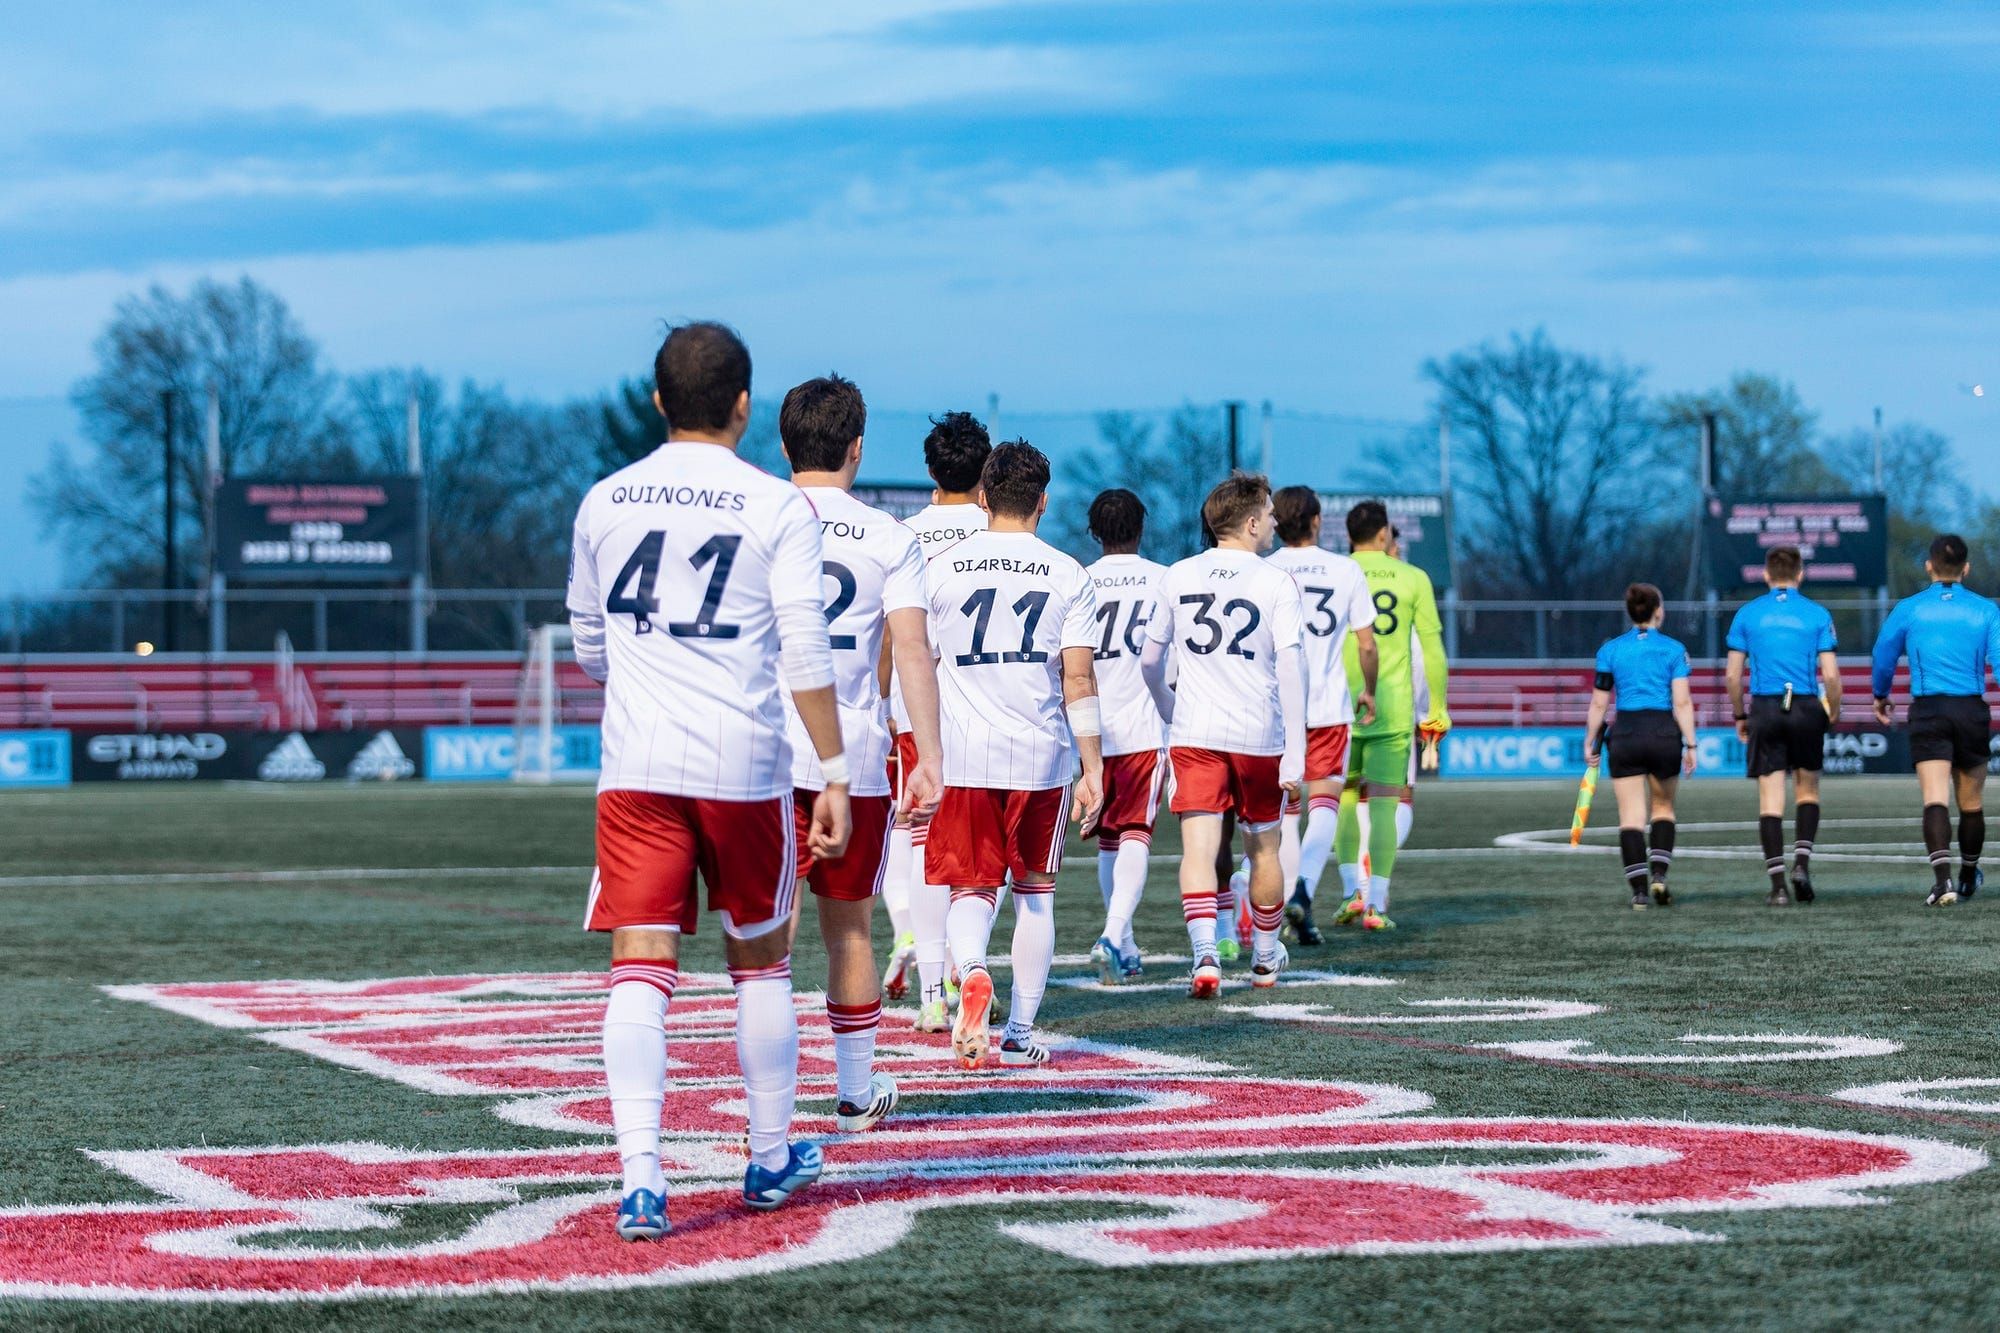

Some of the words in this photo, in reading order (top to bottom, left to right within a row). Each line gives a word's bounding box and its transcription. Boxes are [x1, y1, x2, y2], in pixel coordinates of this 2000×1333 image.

[611, 485, 746, 512] QUINONES
[821, 521, 865, 540] TOU
[953, 558, 1050, 577] DIARBIAN
[1208, 568, 1240, 581] FRY
[606, 530, 743, 639] 41
[1093, 575, 1148, 589] BOLMA
[955, 587, 1050, 667] 11
[1179, 592, 1261, 661] 32
[87, 732, 228, 762] ETIHAD
[1450, 736, 1562, 770] NYCFC
